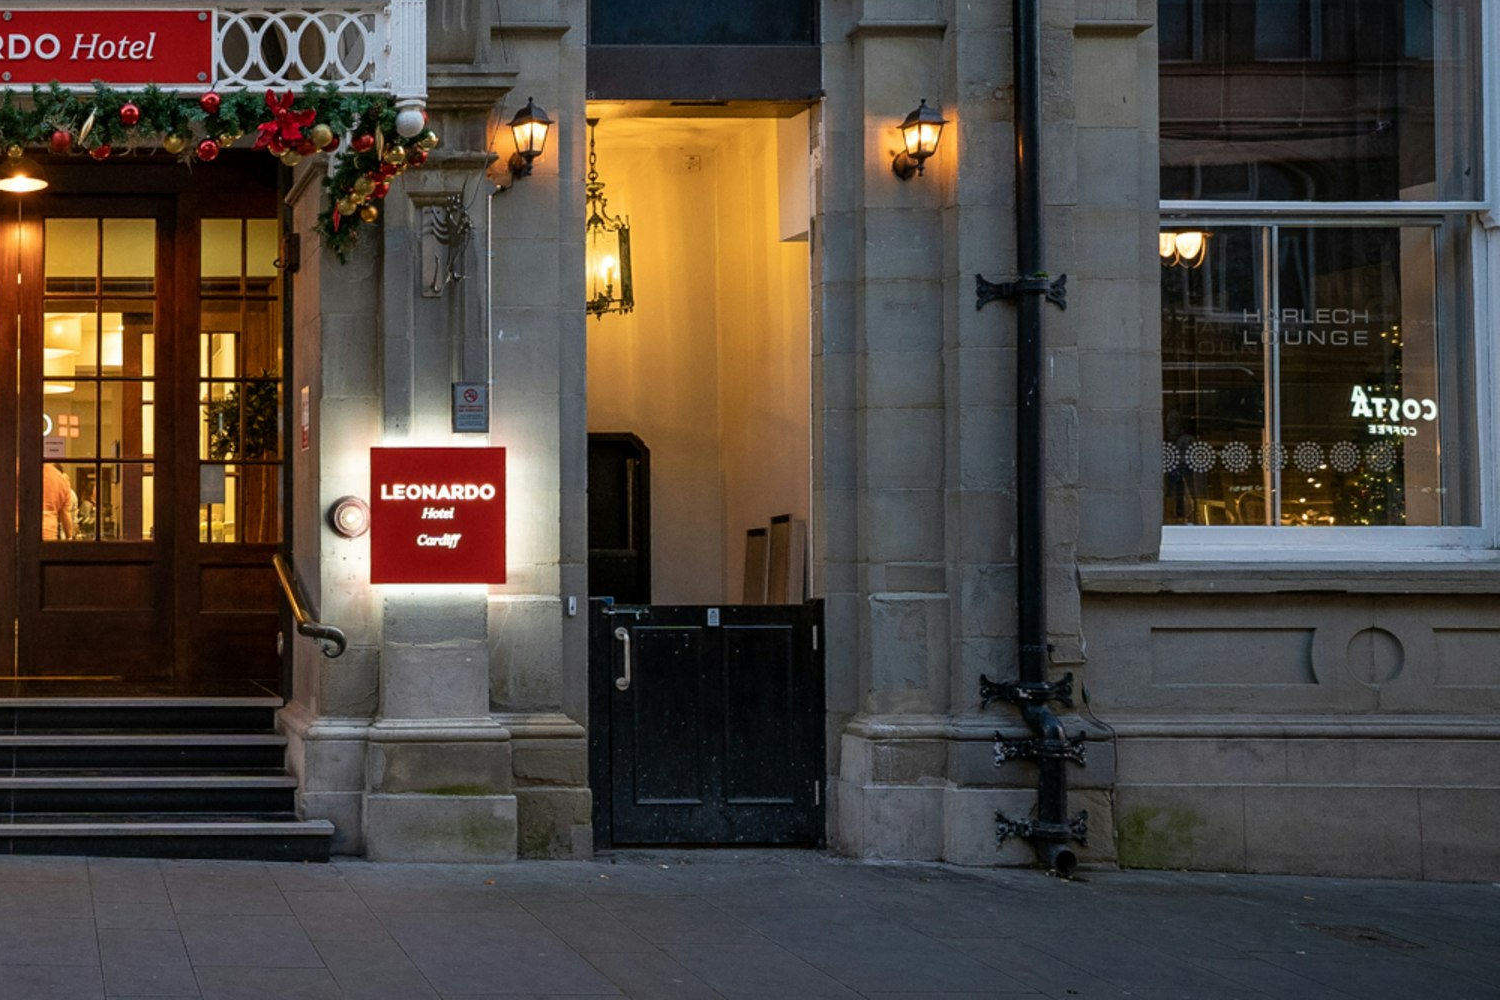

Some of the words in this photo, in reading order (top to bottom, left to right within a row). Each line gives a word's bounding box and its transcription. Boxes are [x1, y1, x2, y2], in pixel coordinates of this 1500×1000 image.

[69, 32, 157, 60] Hotel
[1243, 330, 1369, 346] LOUNGE
[380, 483, 496, 501] LEONARDO
[421, 507, 455, 520] Hotel
[416, 533, 462, 549] Cardiff
